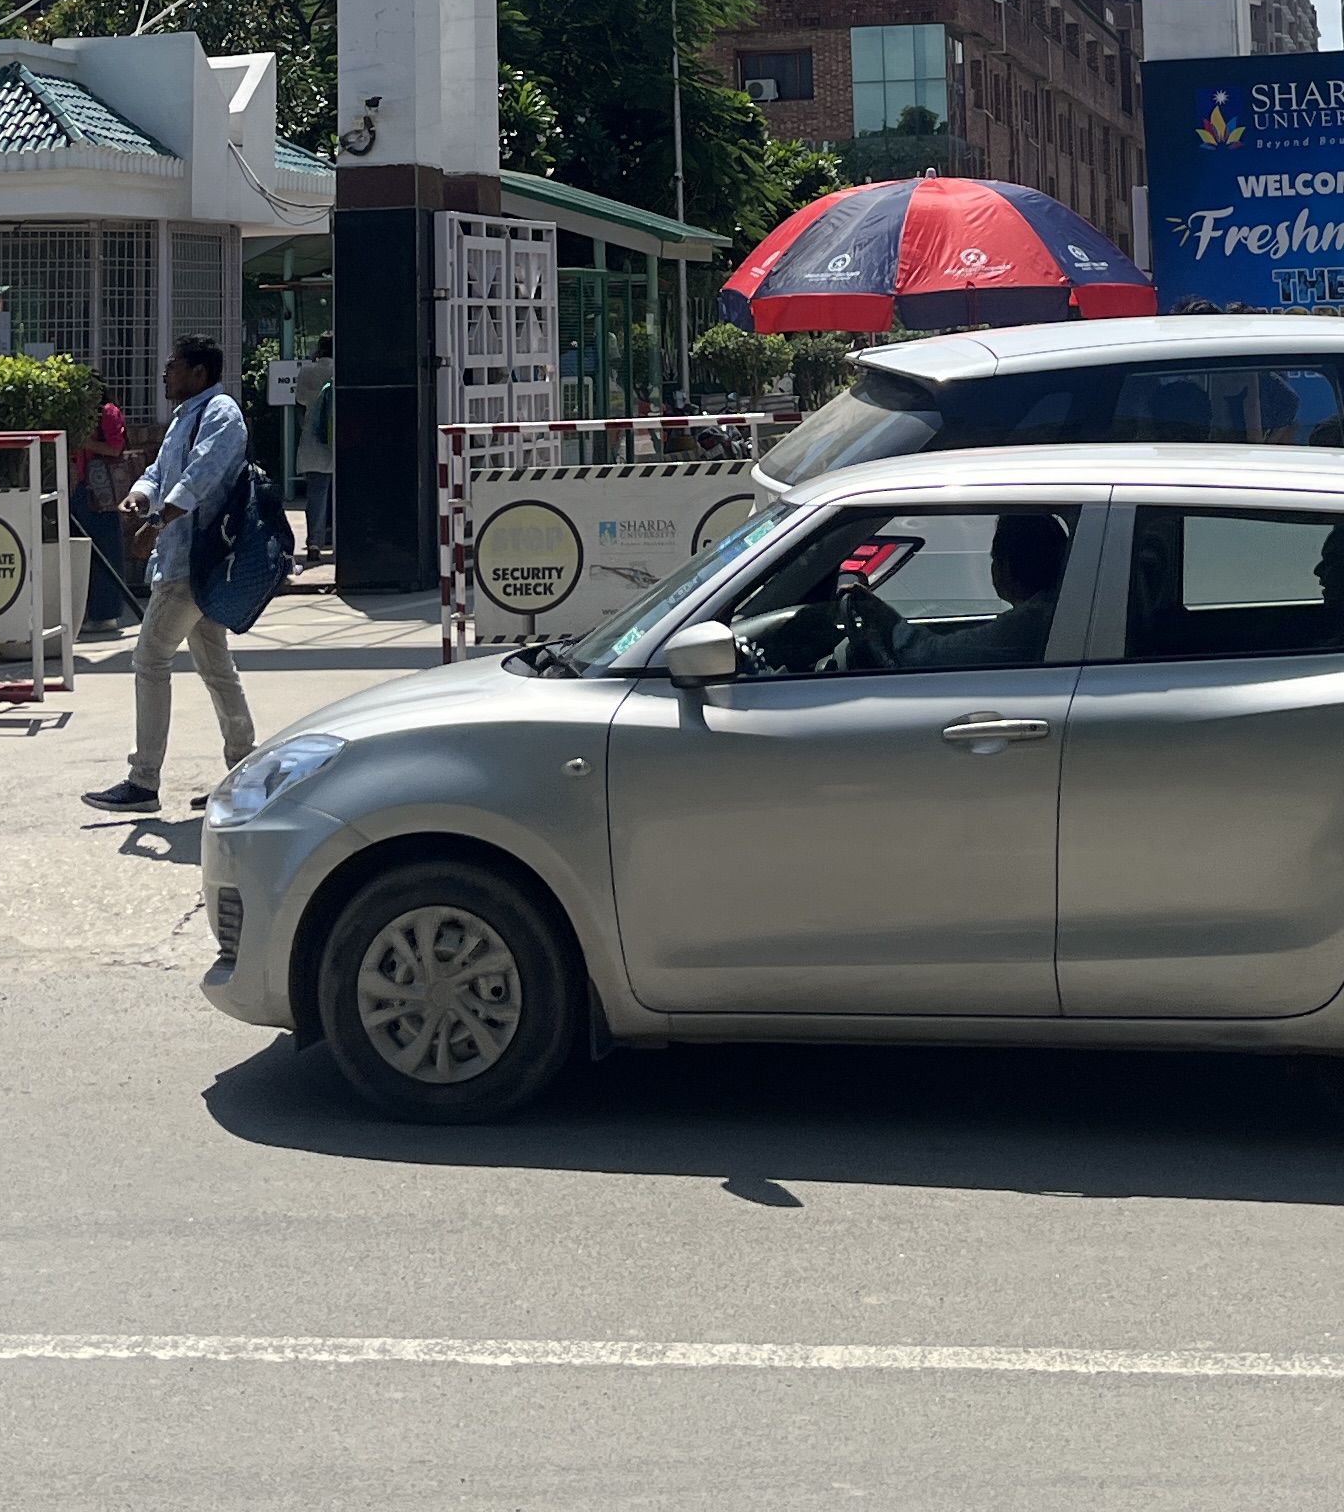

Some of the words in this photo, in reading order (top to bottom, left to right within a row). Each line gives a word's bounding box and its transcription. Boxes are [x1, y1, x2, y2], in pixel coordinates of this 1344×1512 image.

[1256, 136, 1310, 150] Beyond
[619, 519, 676, 531] SHARDA
[619, 531, 676, 539] UNIVERSITY
[492, 566, 565, 581] SECURITY
[502, 582, 555, 596] CHECK
